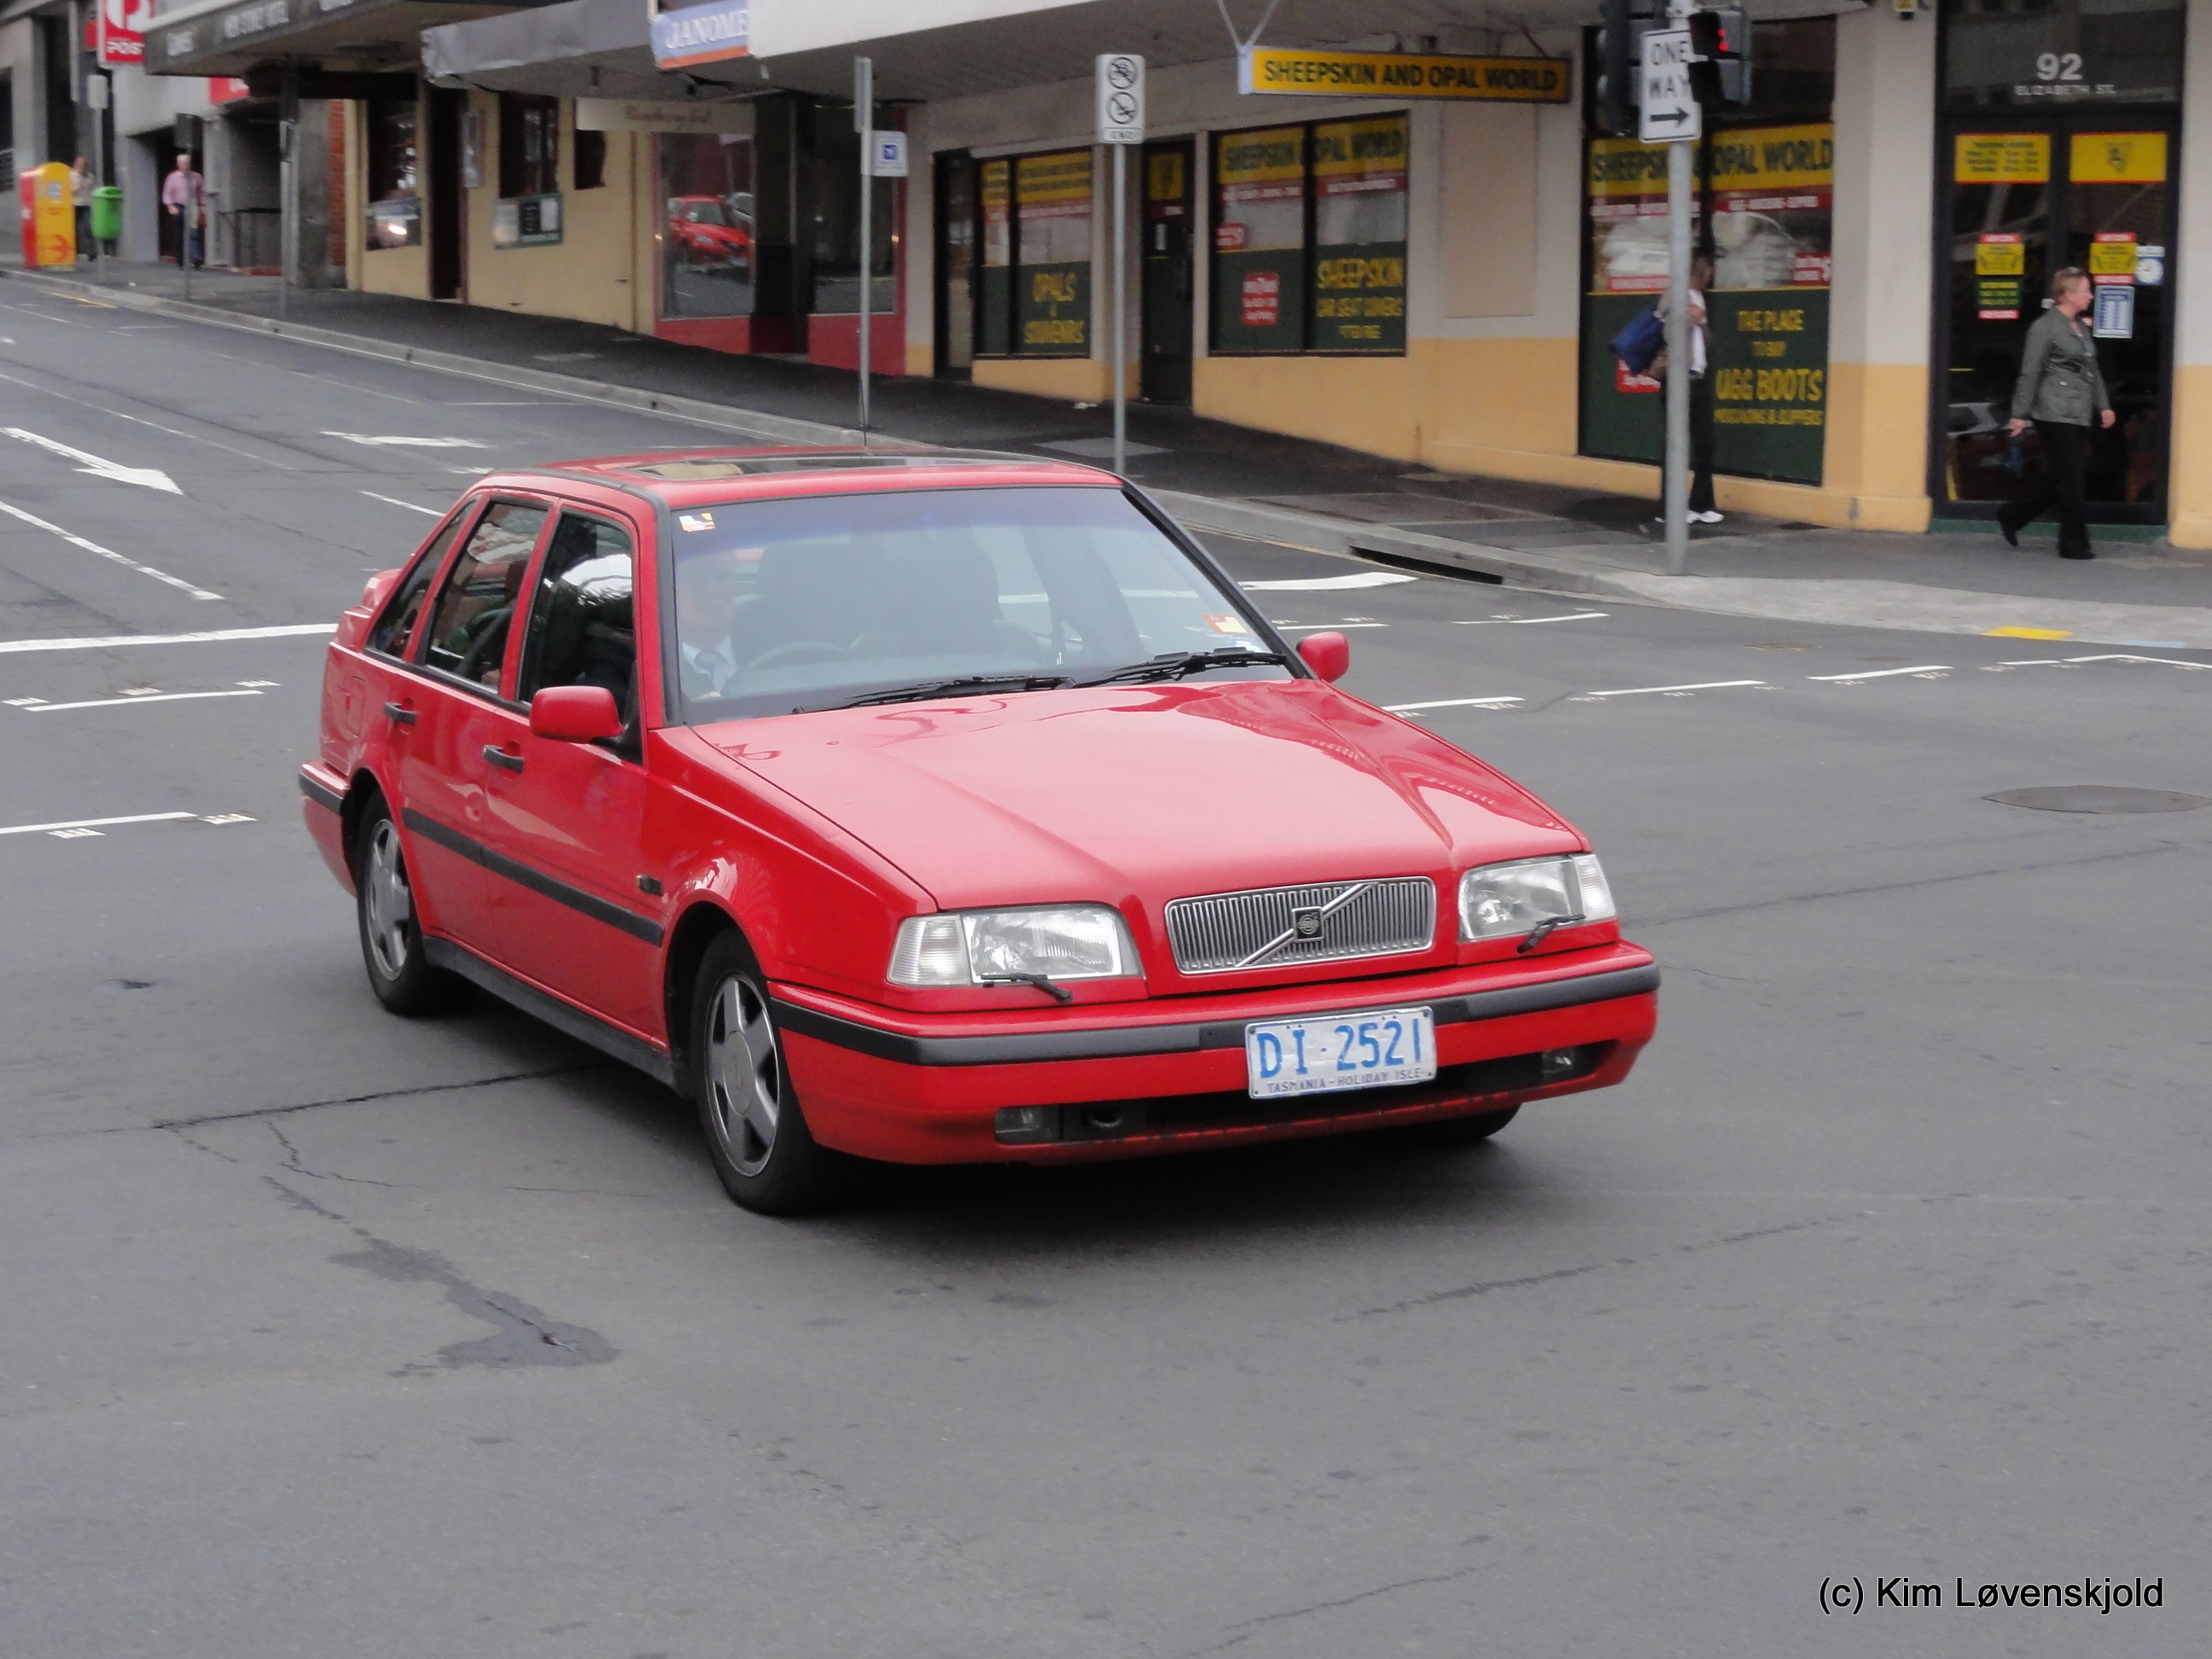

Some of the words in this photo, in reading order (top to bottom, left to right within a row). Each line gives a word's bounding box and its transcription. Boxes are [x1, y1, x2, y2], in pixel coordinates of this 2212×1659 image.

[666, 9, 748, 49] JANOME
[1650, 40, 1689, 66] ONE
[2036, 53, 2082, 80] 92
[1264, 60, 1377, 84] SHEEPSKIN
[1382, 64, 1423, 87] AND
[1429, 66, 1479, 89] OPAL
[1485, 67, 1557, 91] WORLD
[1762, 137, 1834, 173] WORLD
[1317, 258, 1404, 288] SHEEPSKIN
[1738, 310, 1762, 331] THE
[1764, 309, 1804, 331] PLACE
[1716, 368, 1754, 400] UGG
[1757, 368, 1823, 401] BOOTS
[1267, 1078, 1326, 1092] TASMANIA
[1337, 1071, 1388, 1086] HOLIDAY
[1395, 1067, 1421, 1080] ISLE
